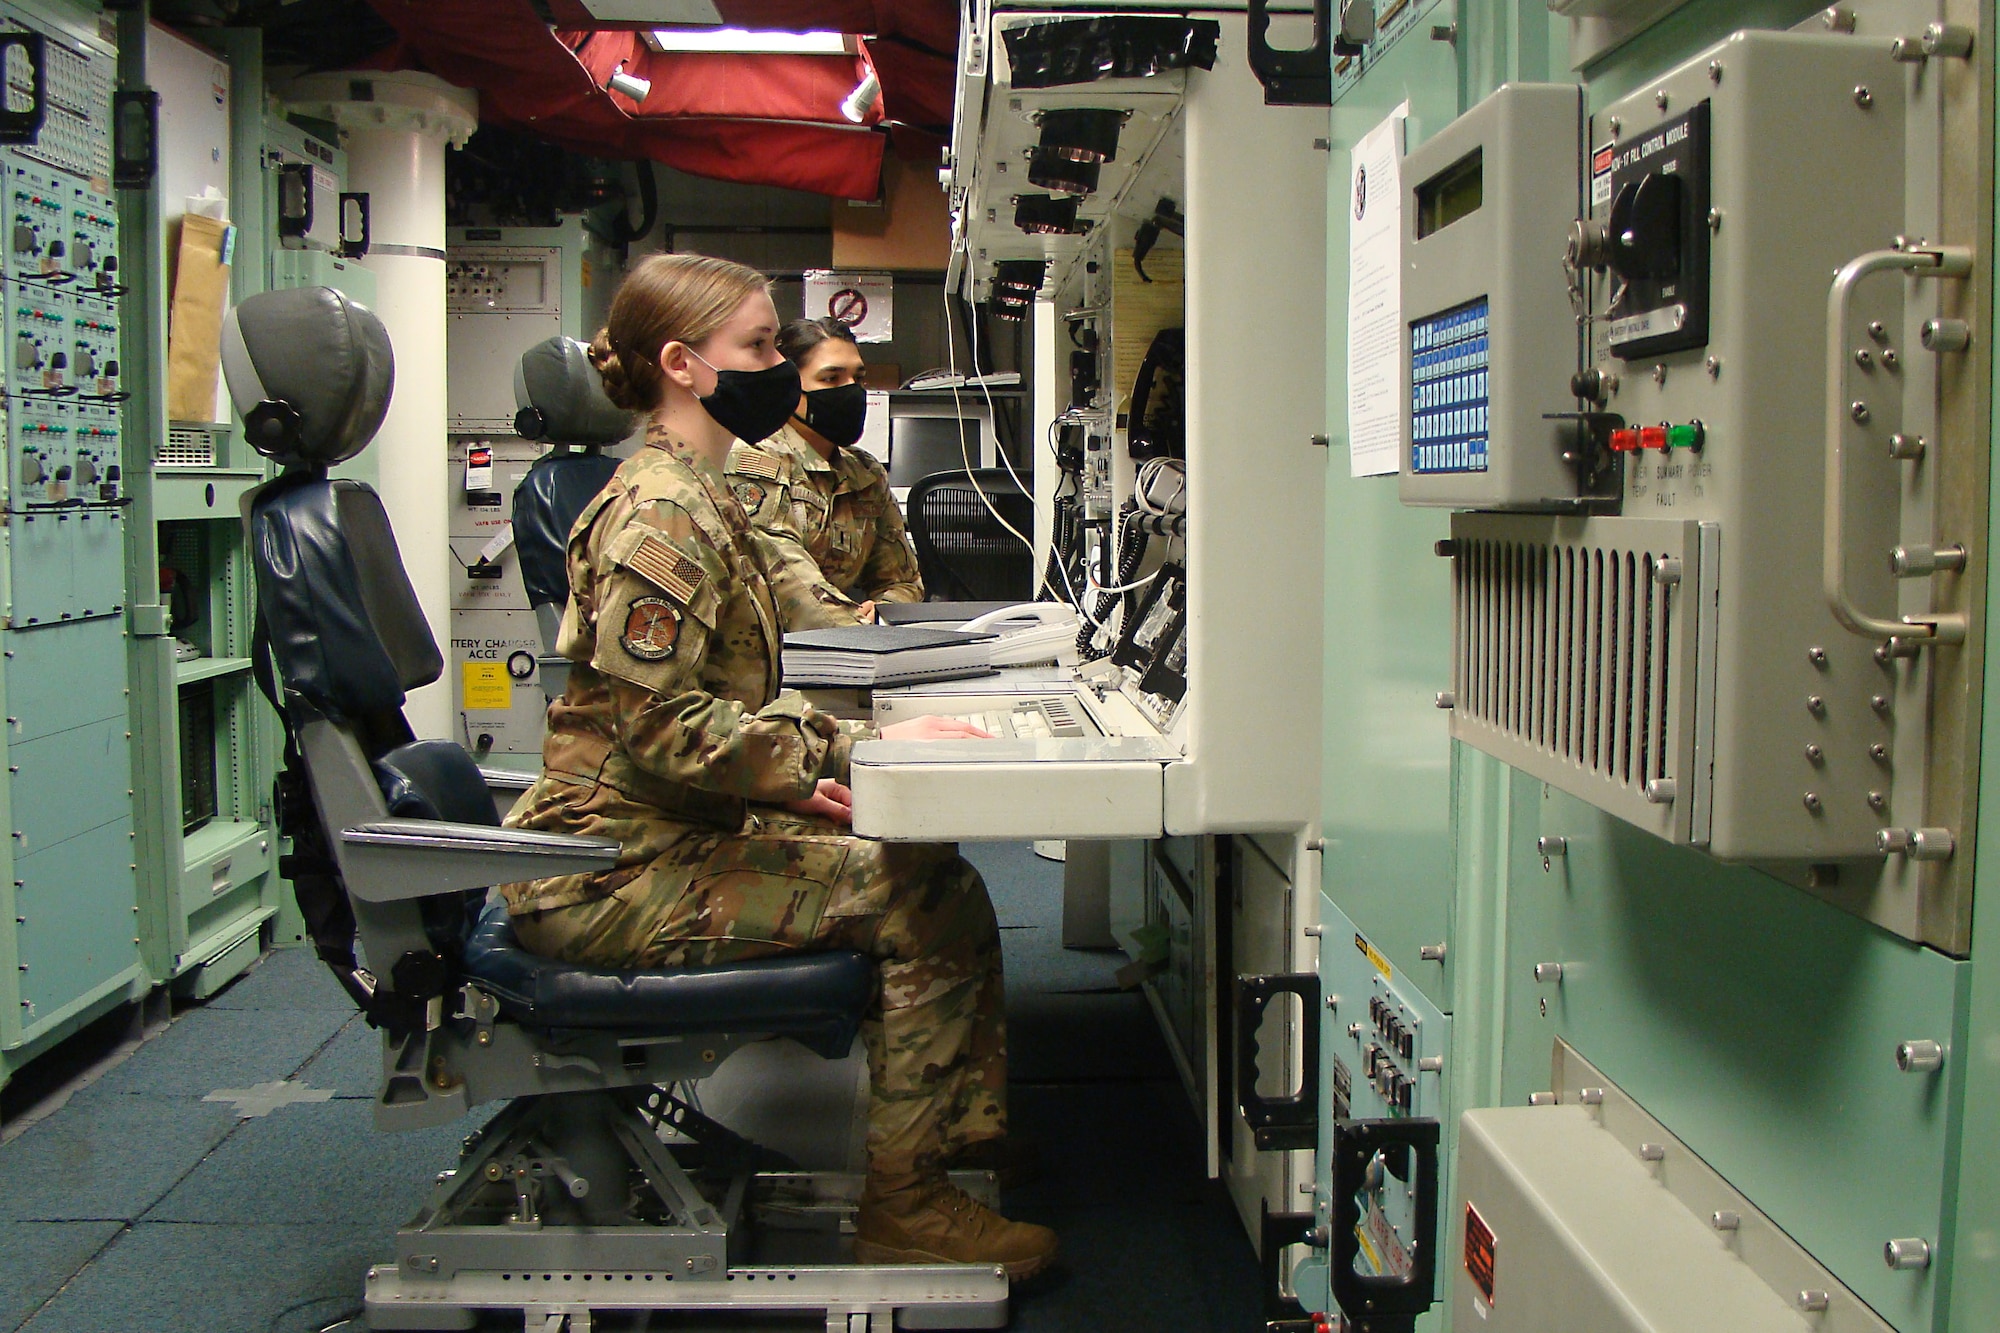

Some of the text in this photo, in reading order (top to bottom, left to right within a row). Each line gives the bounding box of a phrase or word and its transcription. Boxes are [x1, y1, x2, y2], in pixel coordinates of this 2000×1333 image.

[1641, 134, 1665, 158] CONTROL
[1666, 122, 1688, 147] MODULE
[1657, 464, 1683, 479] SUMMARY
[1688, 463, 1712, 477] POWER
[1656, 492, 1676, 507] FAULT
